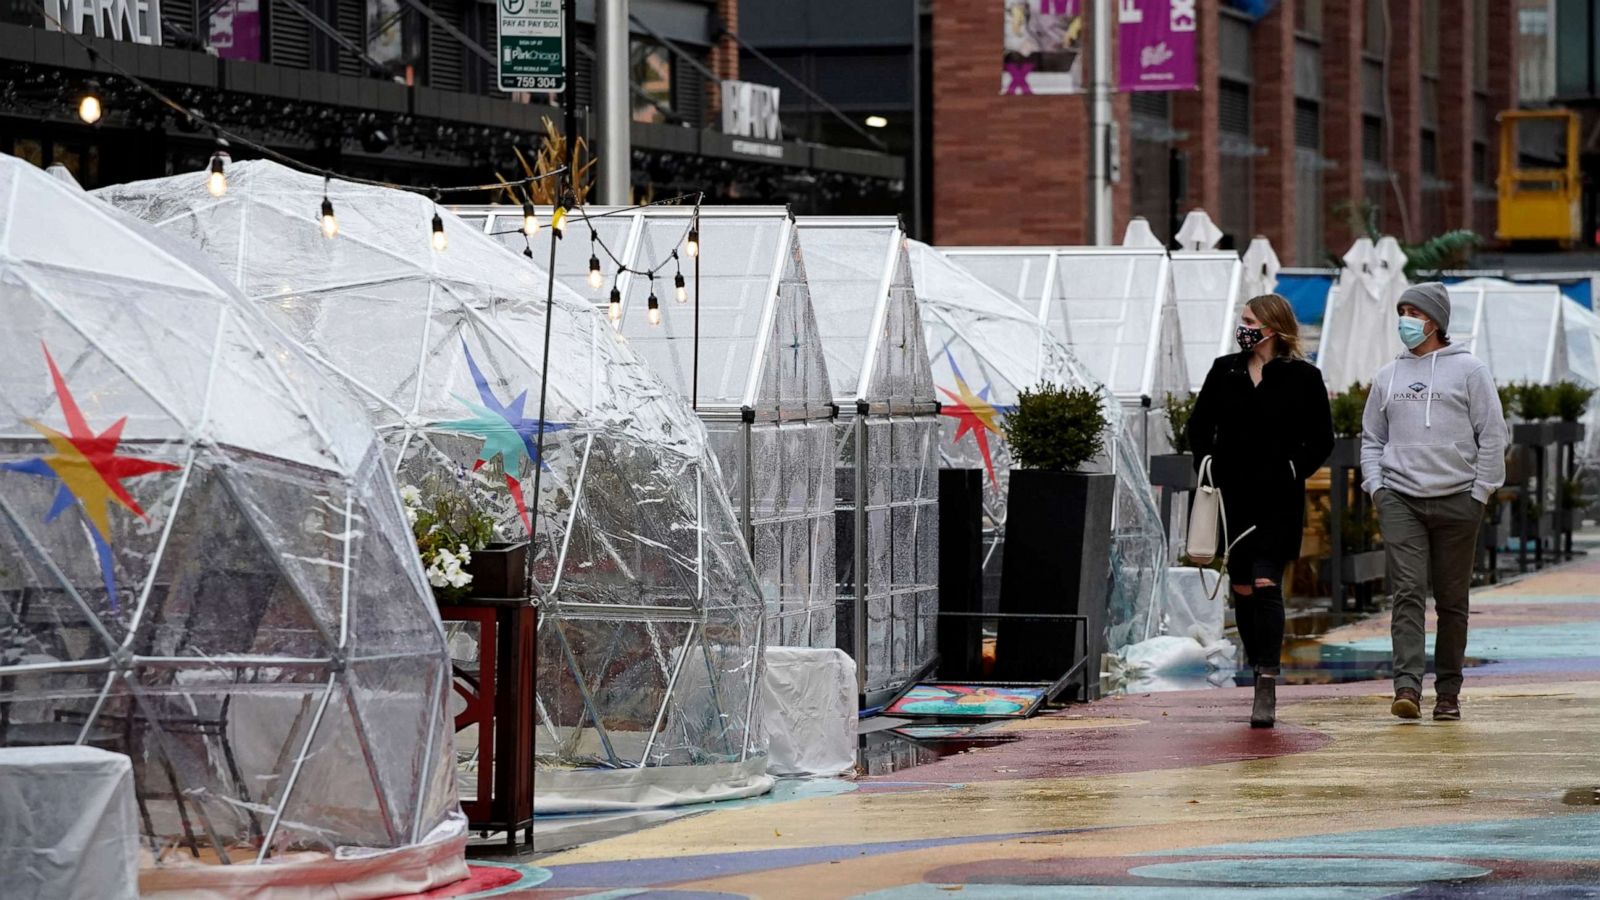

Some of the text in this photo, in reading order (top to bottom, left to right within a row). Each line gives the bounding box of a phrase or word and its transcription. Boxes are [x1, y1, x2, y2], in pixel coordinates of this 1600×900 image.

[527, 20, 542, 28] PAY
[516, 76, 535, 87] 759
[537, 77, 556, 88] 304
[1393, 392, 1418, 400] PARK
